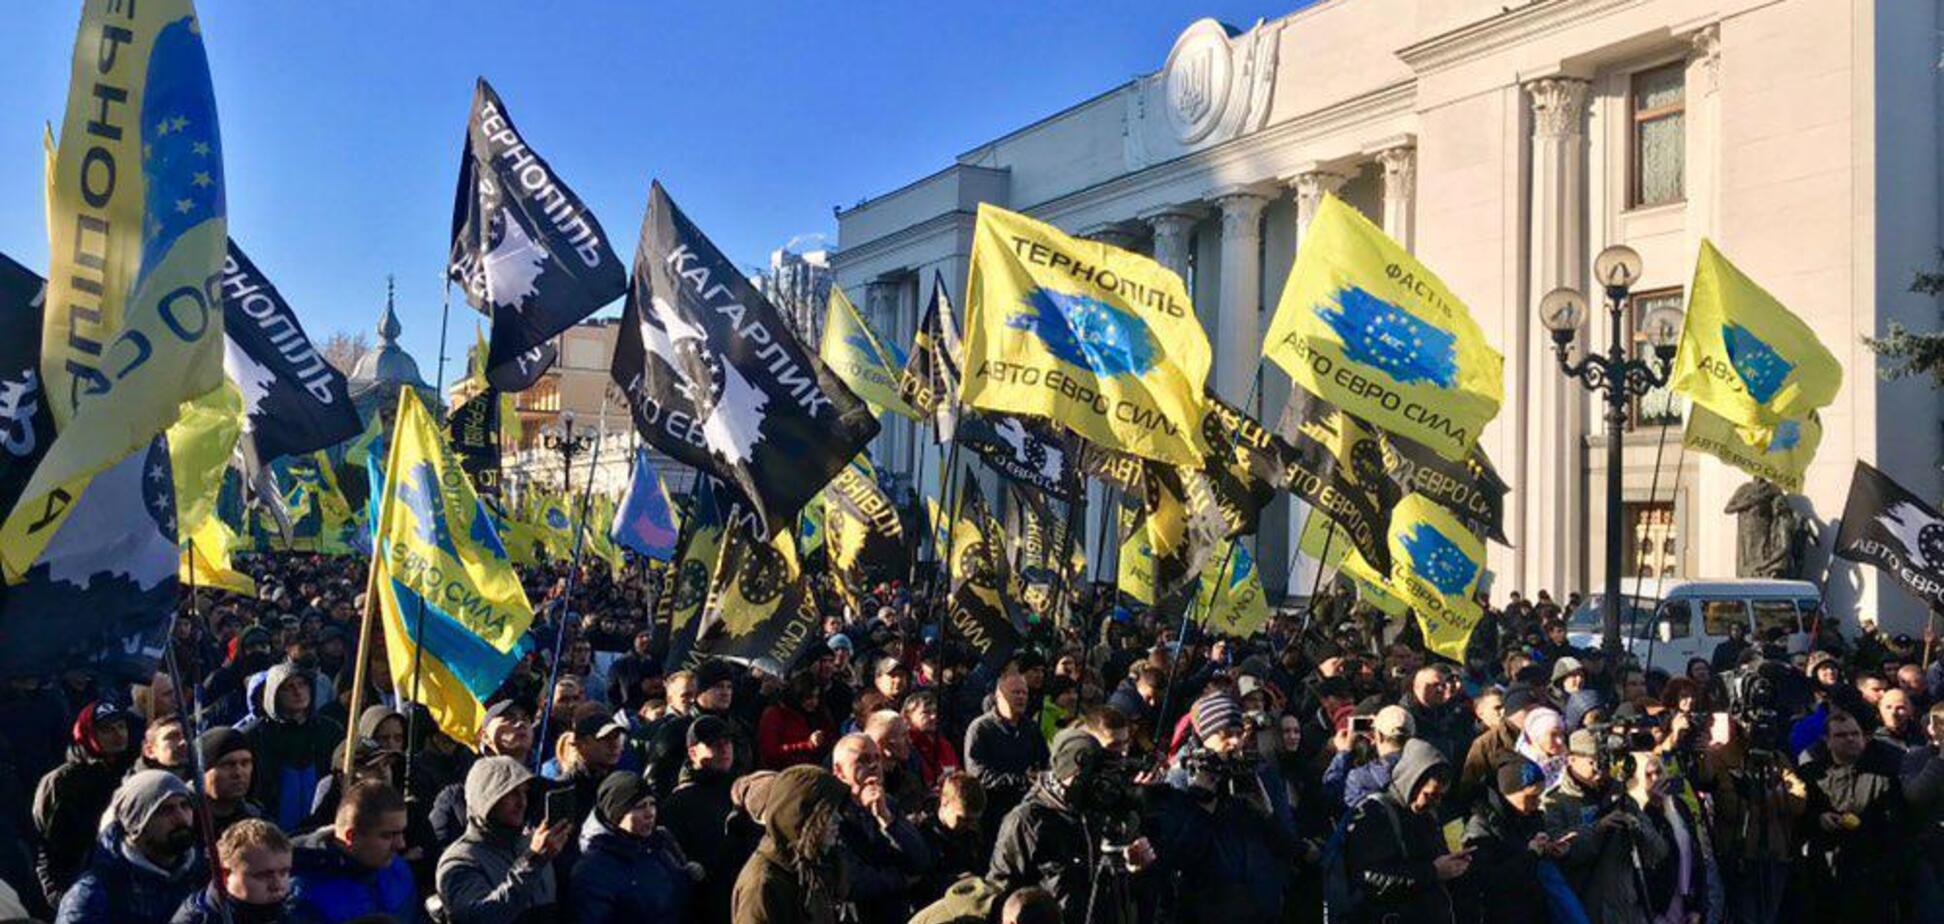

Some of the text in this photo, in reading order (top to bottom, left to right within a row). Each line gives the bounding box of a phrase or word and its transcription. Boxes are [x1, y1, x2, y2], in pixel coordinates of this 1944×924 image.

[479, 99, 601, 268] ТЕРНОПІЛЬ
[1012, 235, 1185, 319] ТЕРНОПІЛЬ
[222, 254, 335, 404] РНОПІЛЬ
[666, 243, 832, 419] КАГАРЛИК
[976, 359, 1040, 387] АВТО
[1044, 369, 1110, 416] ЄВРО
[1283, 331, 1468, 447] АВТО ЄВРО СИЛА
[1849, 538, 1899, 571] АВТО
[445, 580, 513, 635] СИЛА
